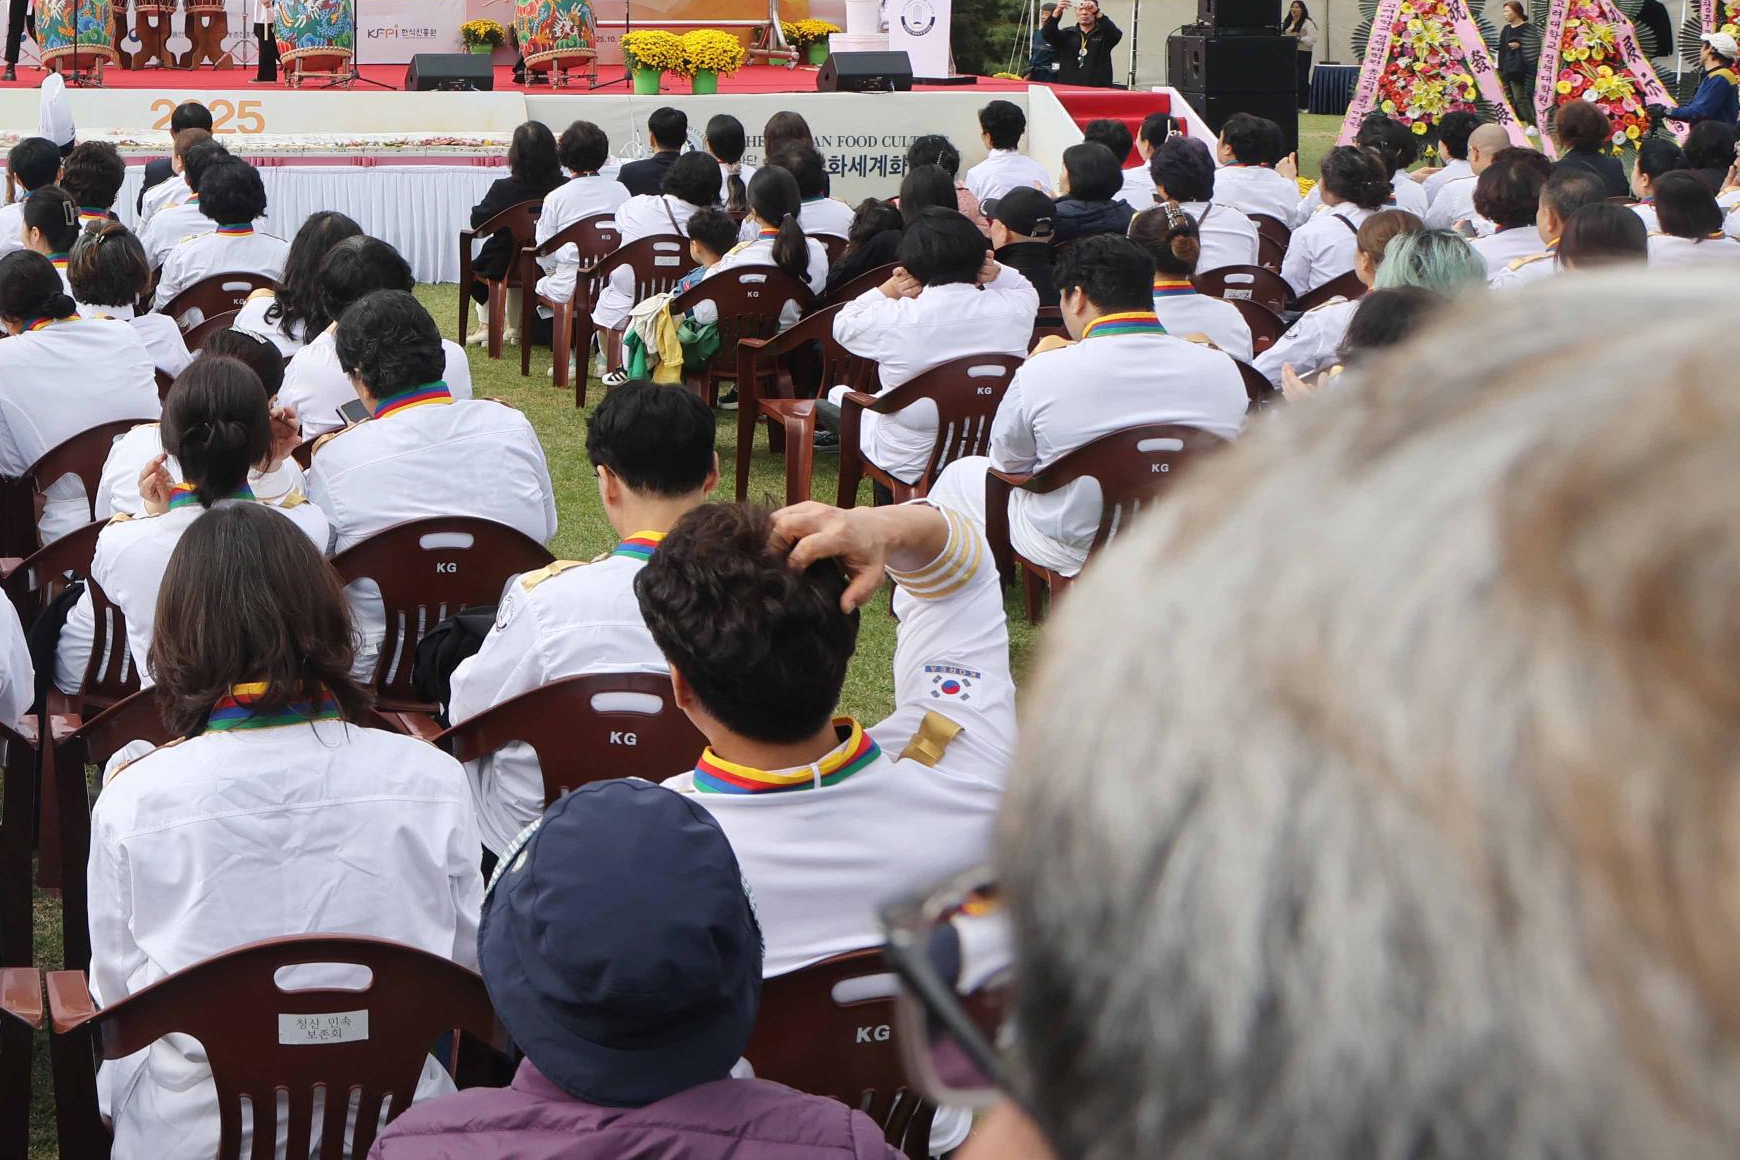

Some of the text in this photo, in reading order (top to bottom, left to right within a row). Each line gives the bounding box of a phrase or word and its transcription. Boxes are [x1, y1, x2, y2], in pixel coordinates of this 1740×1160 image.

[1545, 0, 1566, 50] 고려대학교
[1538, 52, 1554, 107] 정책대학원
[150, 98, 266, 134] 225
[837, 135, 878, 148] FOOD
[977, 387, 992, 395] KG
[1151, 463, 1169, 473] KG
[436, 562, 457, 573] KG
[609, 731, 637, 746] KG
[855, 1024, 891, 1044] KG
